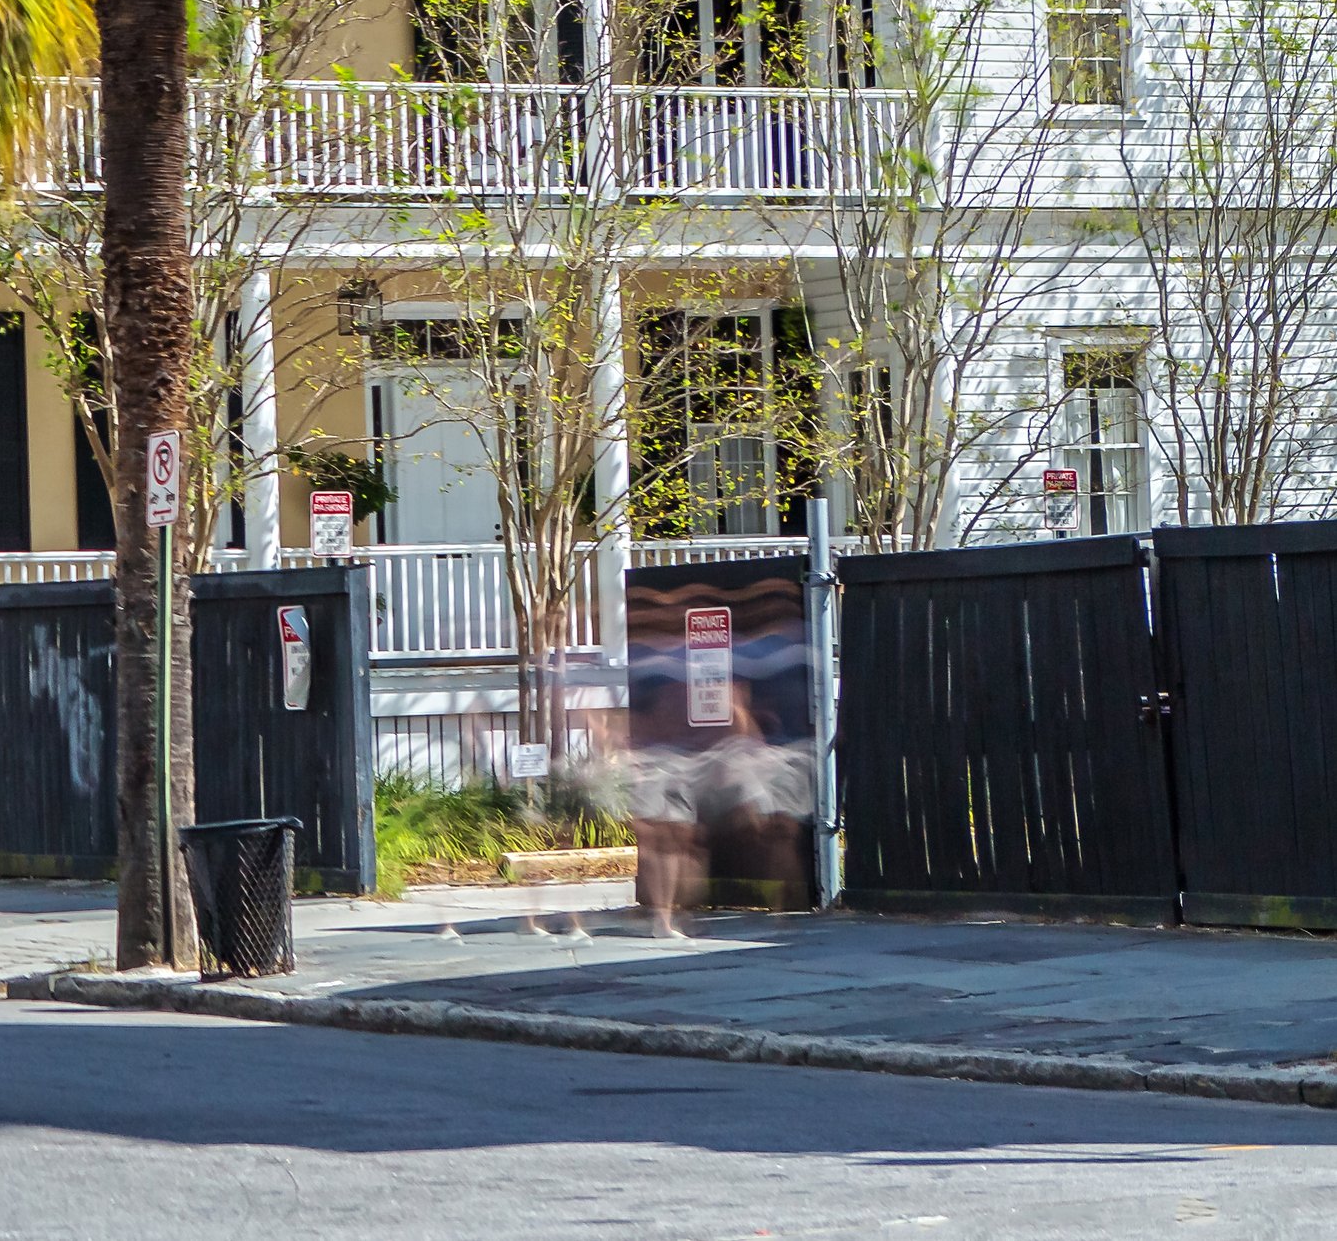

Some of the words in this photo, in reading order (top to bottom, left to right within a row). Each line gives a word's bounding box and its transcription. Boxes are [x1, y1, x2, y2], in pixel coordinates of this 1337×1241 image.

[1045, 472, 1075, 480] PRIVATE
[314, 495, 348, 504] PRIVATE
[313, 504, 349, 512] PARKING
[690, 615, 727, 630] PRIVATE
[689, 630, 729, 645] PARKING
